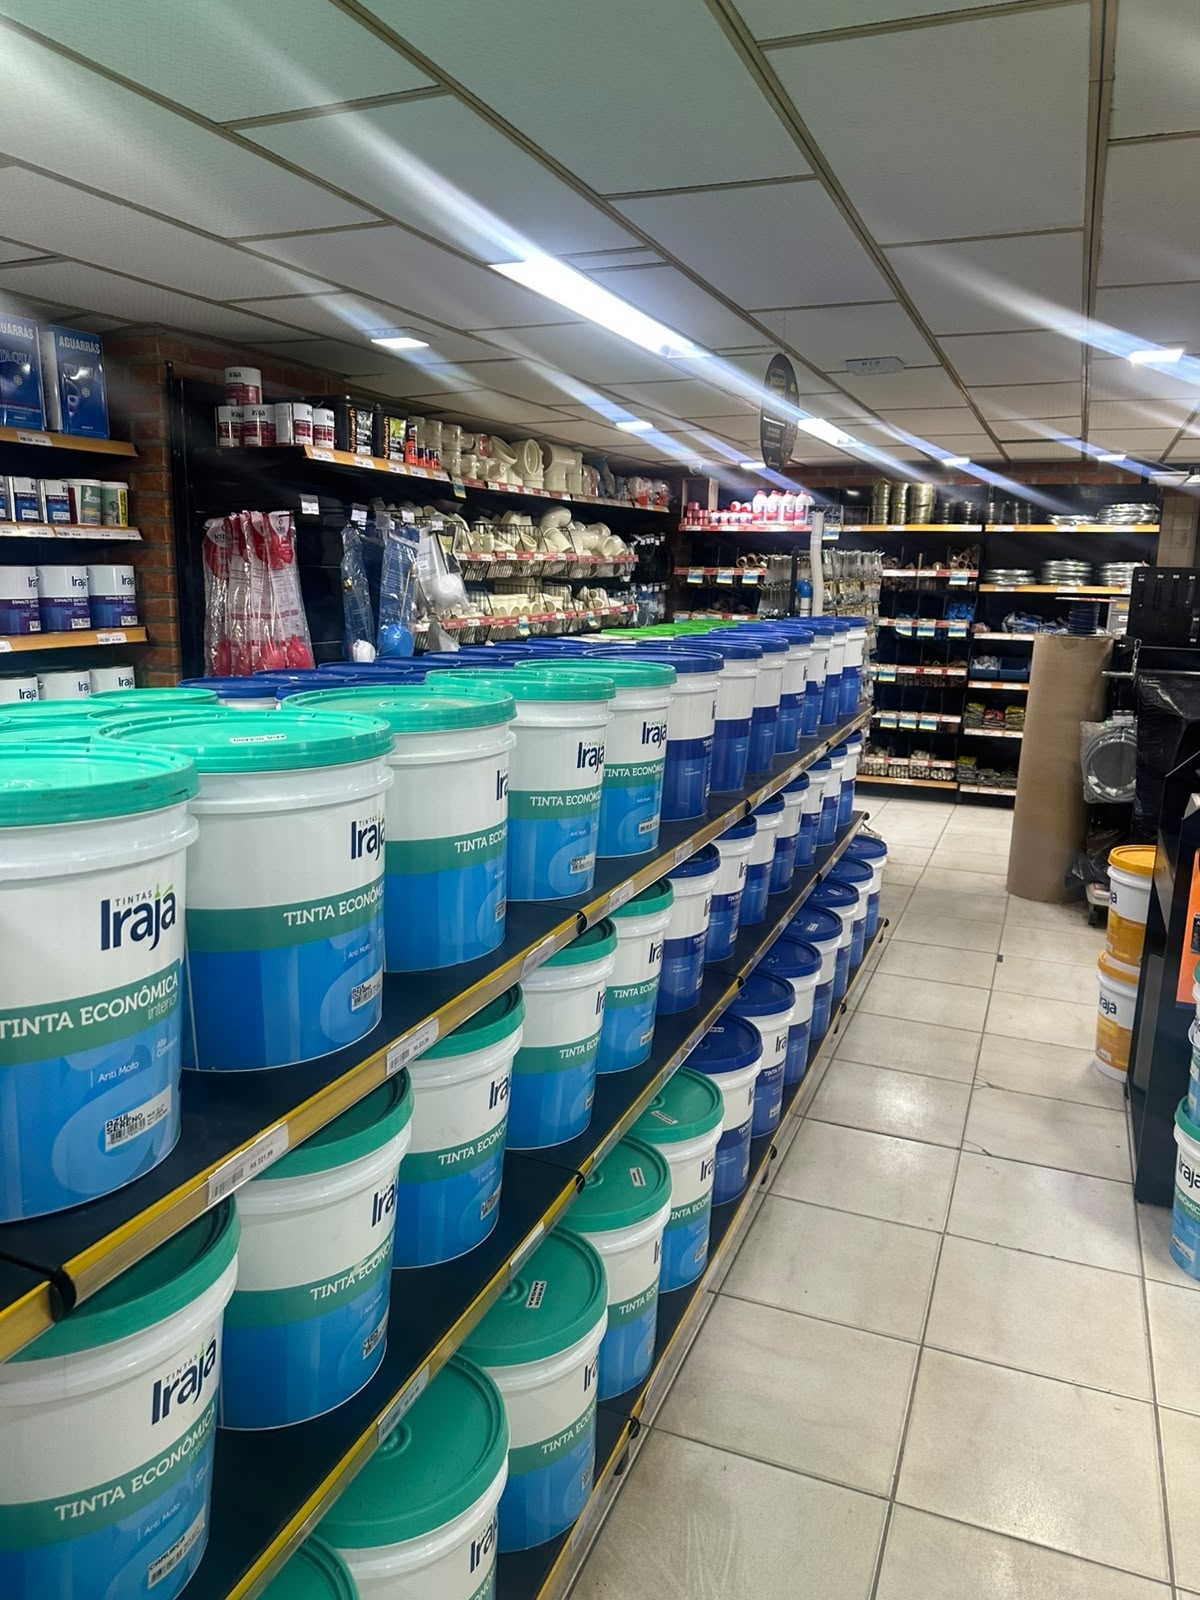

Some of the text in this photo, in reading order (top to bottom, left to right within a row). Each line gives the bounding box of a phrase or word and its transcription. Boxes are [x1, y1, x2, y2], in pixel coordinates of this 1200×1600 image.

[530, 796, 563, 807] TINTA
[454, 836, 487, 853] TINTA
[115, 889, 153, 906] TINTAS
[283, 905, 335, 926] TINTA
[613, 987, 639, 998] TINTA
[0, 971, 178, 1039] TINTA ECONÔMICA
[560, 1045, 585, 1059] TINTA
[98, 1061, 140, 1083] Anti Mofo
[106, 1112, 144, 1135] SERENO
[438, 1146, 475, 1165] TINTA
[310, 1273, 355, 1301] TINTA
[619, 1296, 645, 1315] TINTA
[165, 1352, 198, 1383] TINTAS
[541, 1429, 574, 1455] TINTA
[54, 1486, 125, 1521] TINTA
